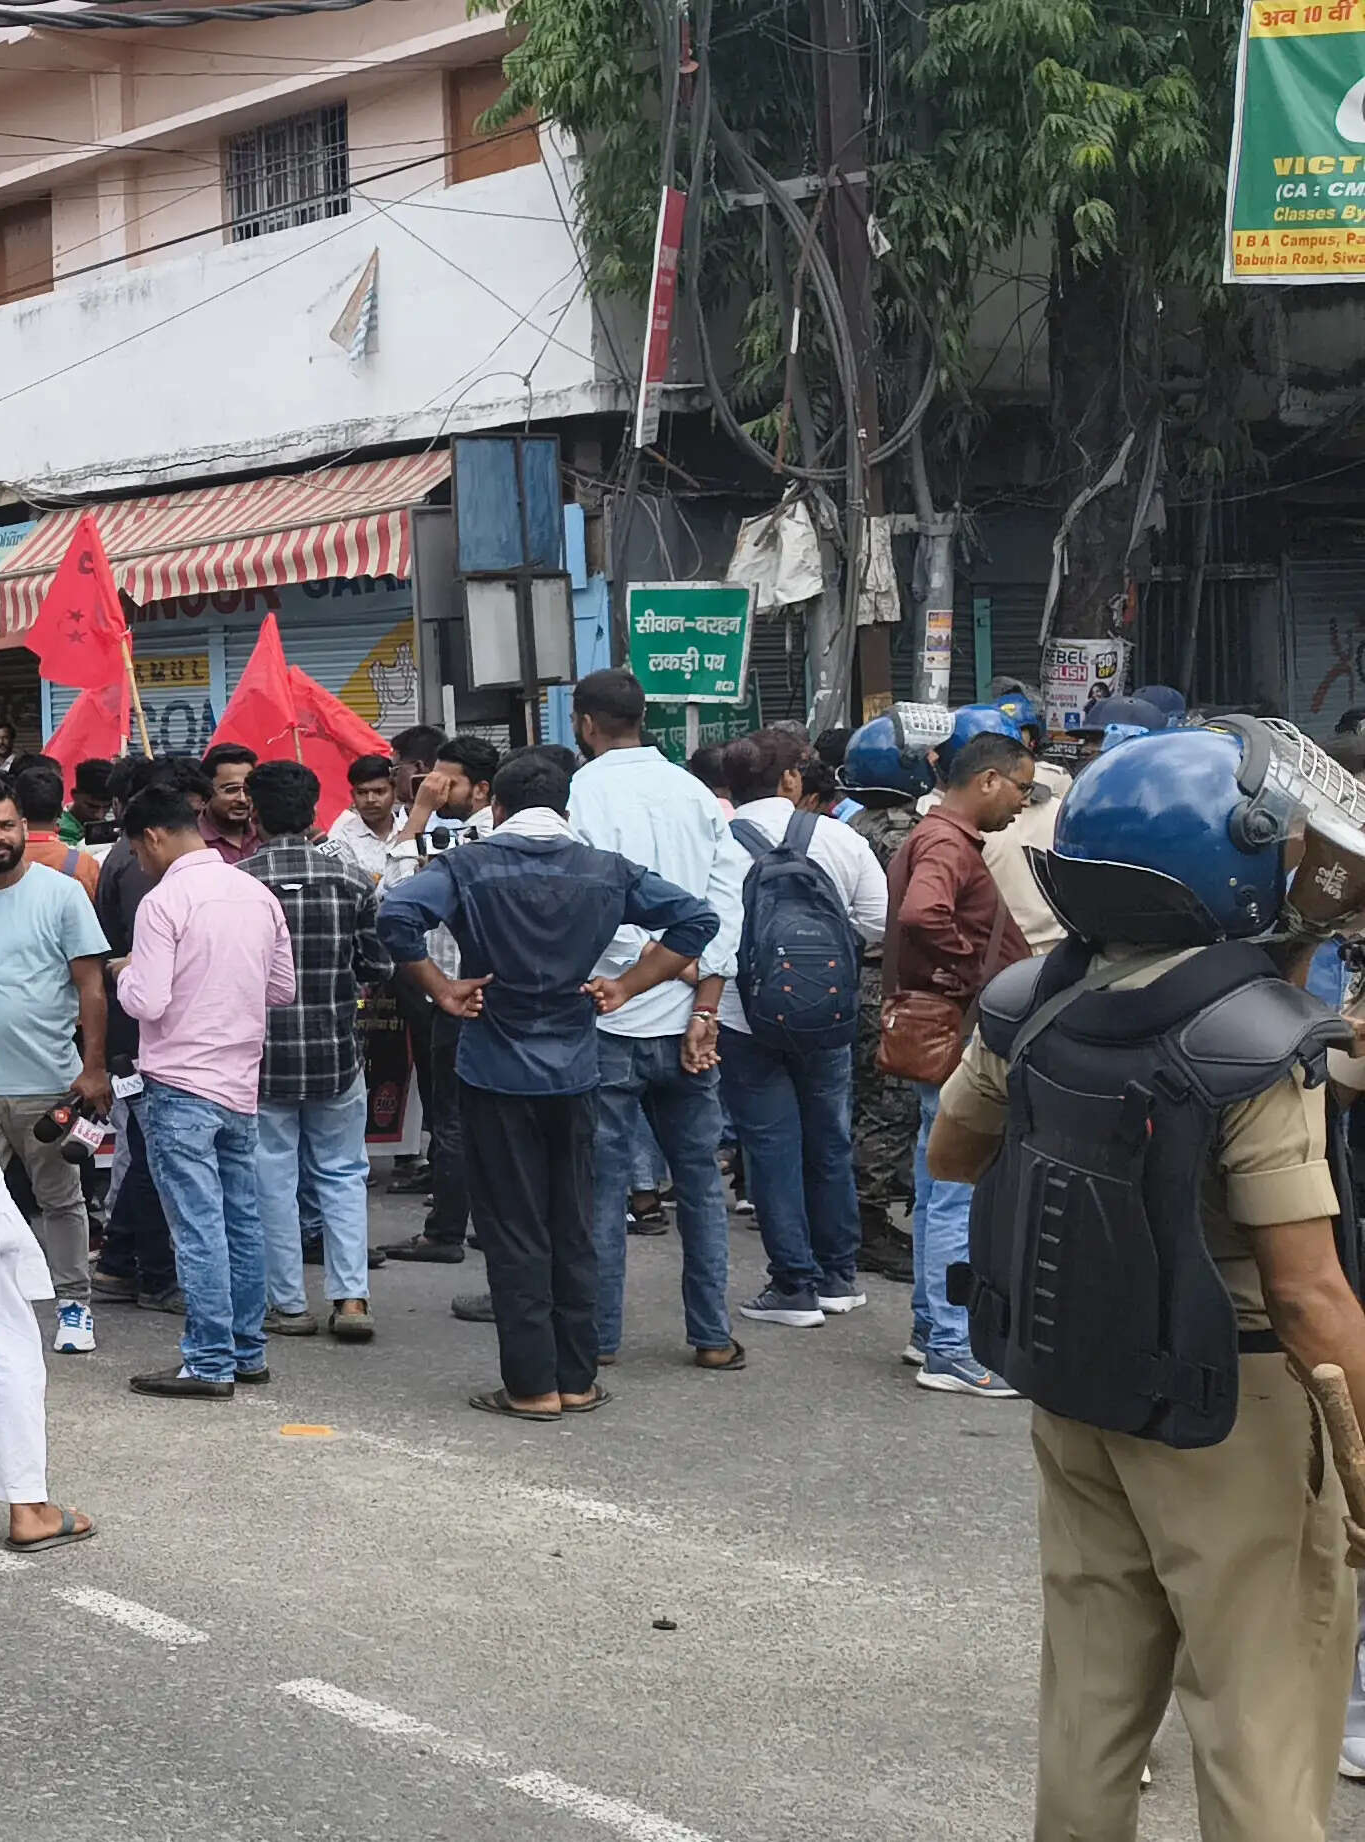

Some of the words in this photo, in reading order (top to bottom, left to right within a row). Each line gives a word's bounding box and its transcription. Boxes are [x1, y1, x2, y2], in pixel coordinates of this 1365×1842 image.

[1259, 9, 1296, 28] अब
[1303, 6, 1322, 24] 10
[1273, 155, 1365, 176] VICT
[1275, 182, 1308, 202] (CA
[1327, 181, 1365, 198] CM
[1273, 205, 1336, 222] Classes
[1280, 233, 1341, 251] Campus,
[1346, 232, 1365, 246] Pa
[1235, 253, 1287, 266] Babunia
[1292, 252, 1328, 266] Road,
[1332, 250, 1365, 265] Siwa
[648, 646, 700, 680] लकड़ी
[703, 654, 727, 671] पथ
[1046, 649, 1087, 665] EBEL
[1051, 665, 1087, 680] GLISH
